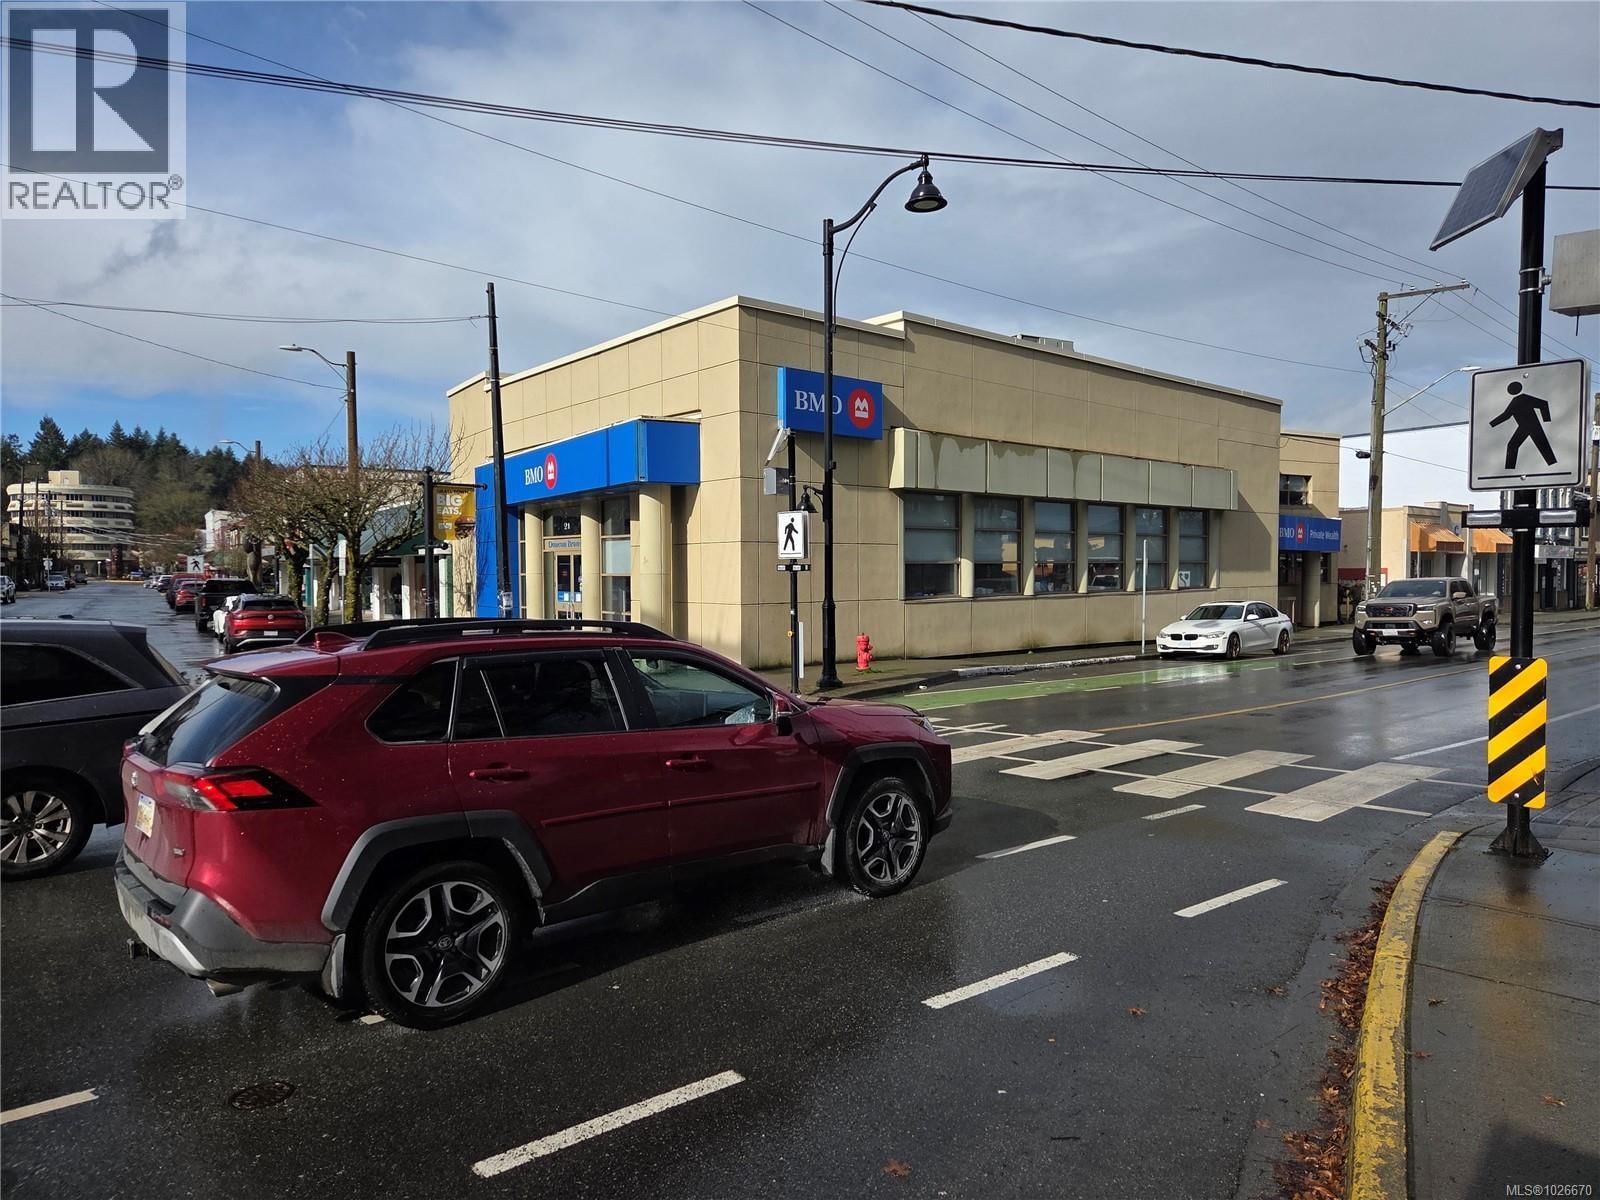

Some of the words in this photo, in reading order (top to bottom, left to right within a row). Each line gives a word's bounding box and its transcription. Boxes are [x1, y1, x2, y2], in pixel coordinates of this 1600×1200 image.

[794, 389, 843, 415] BMO
[525, 466, 544, 486] BMO
[436, 494, 463, 506] BIG
[436, 506, 462, 515] EATS.
[1279, 527, 1295, 538] BMO
